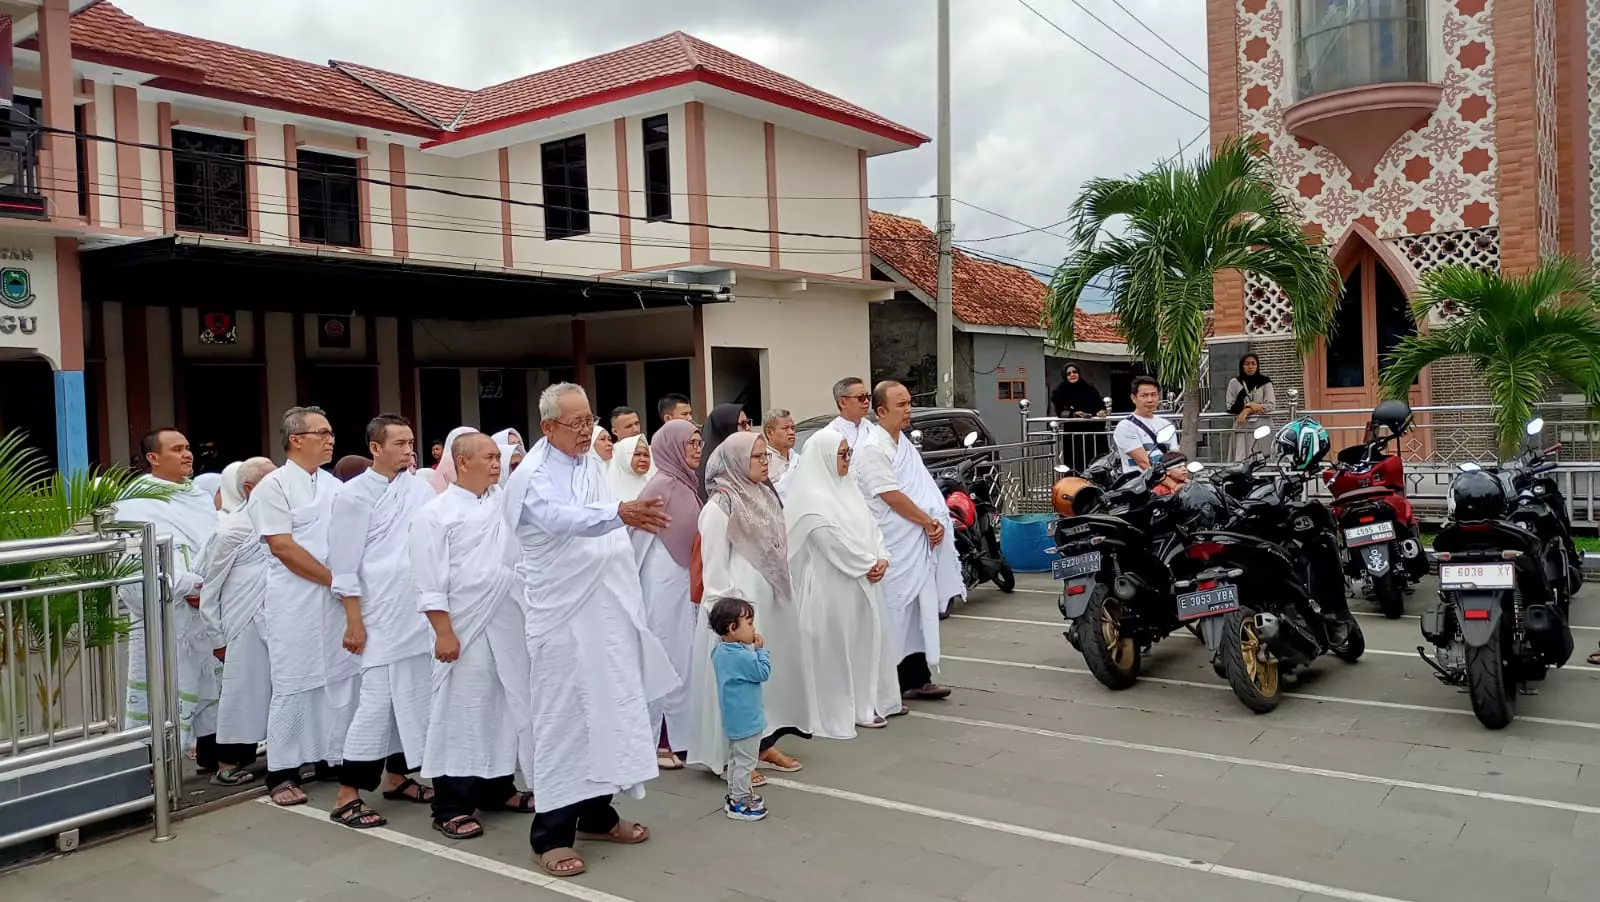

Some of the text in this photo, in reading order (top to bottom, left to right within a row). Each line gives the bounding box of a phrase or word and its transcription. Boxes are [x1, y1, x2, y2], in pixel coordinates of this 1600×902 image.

[0, 315, 37, 334] GU
[1053, 562, 1060, 570] E
[1444, 566, 1511, 577] E 6038 XY
[1181, 589, 1234, 609] E 3053 YBA
